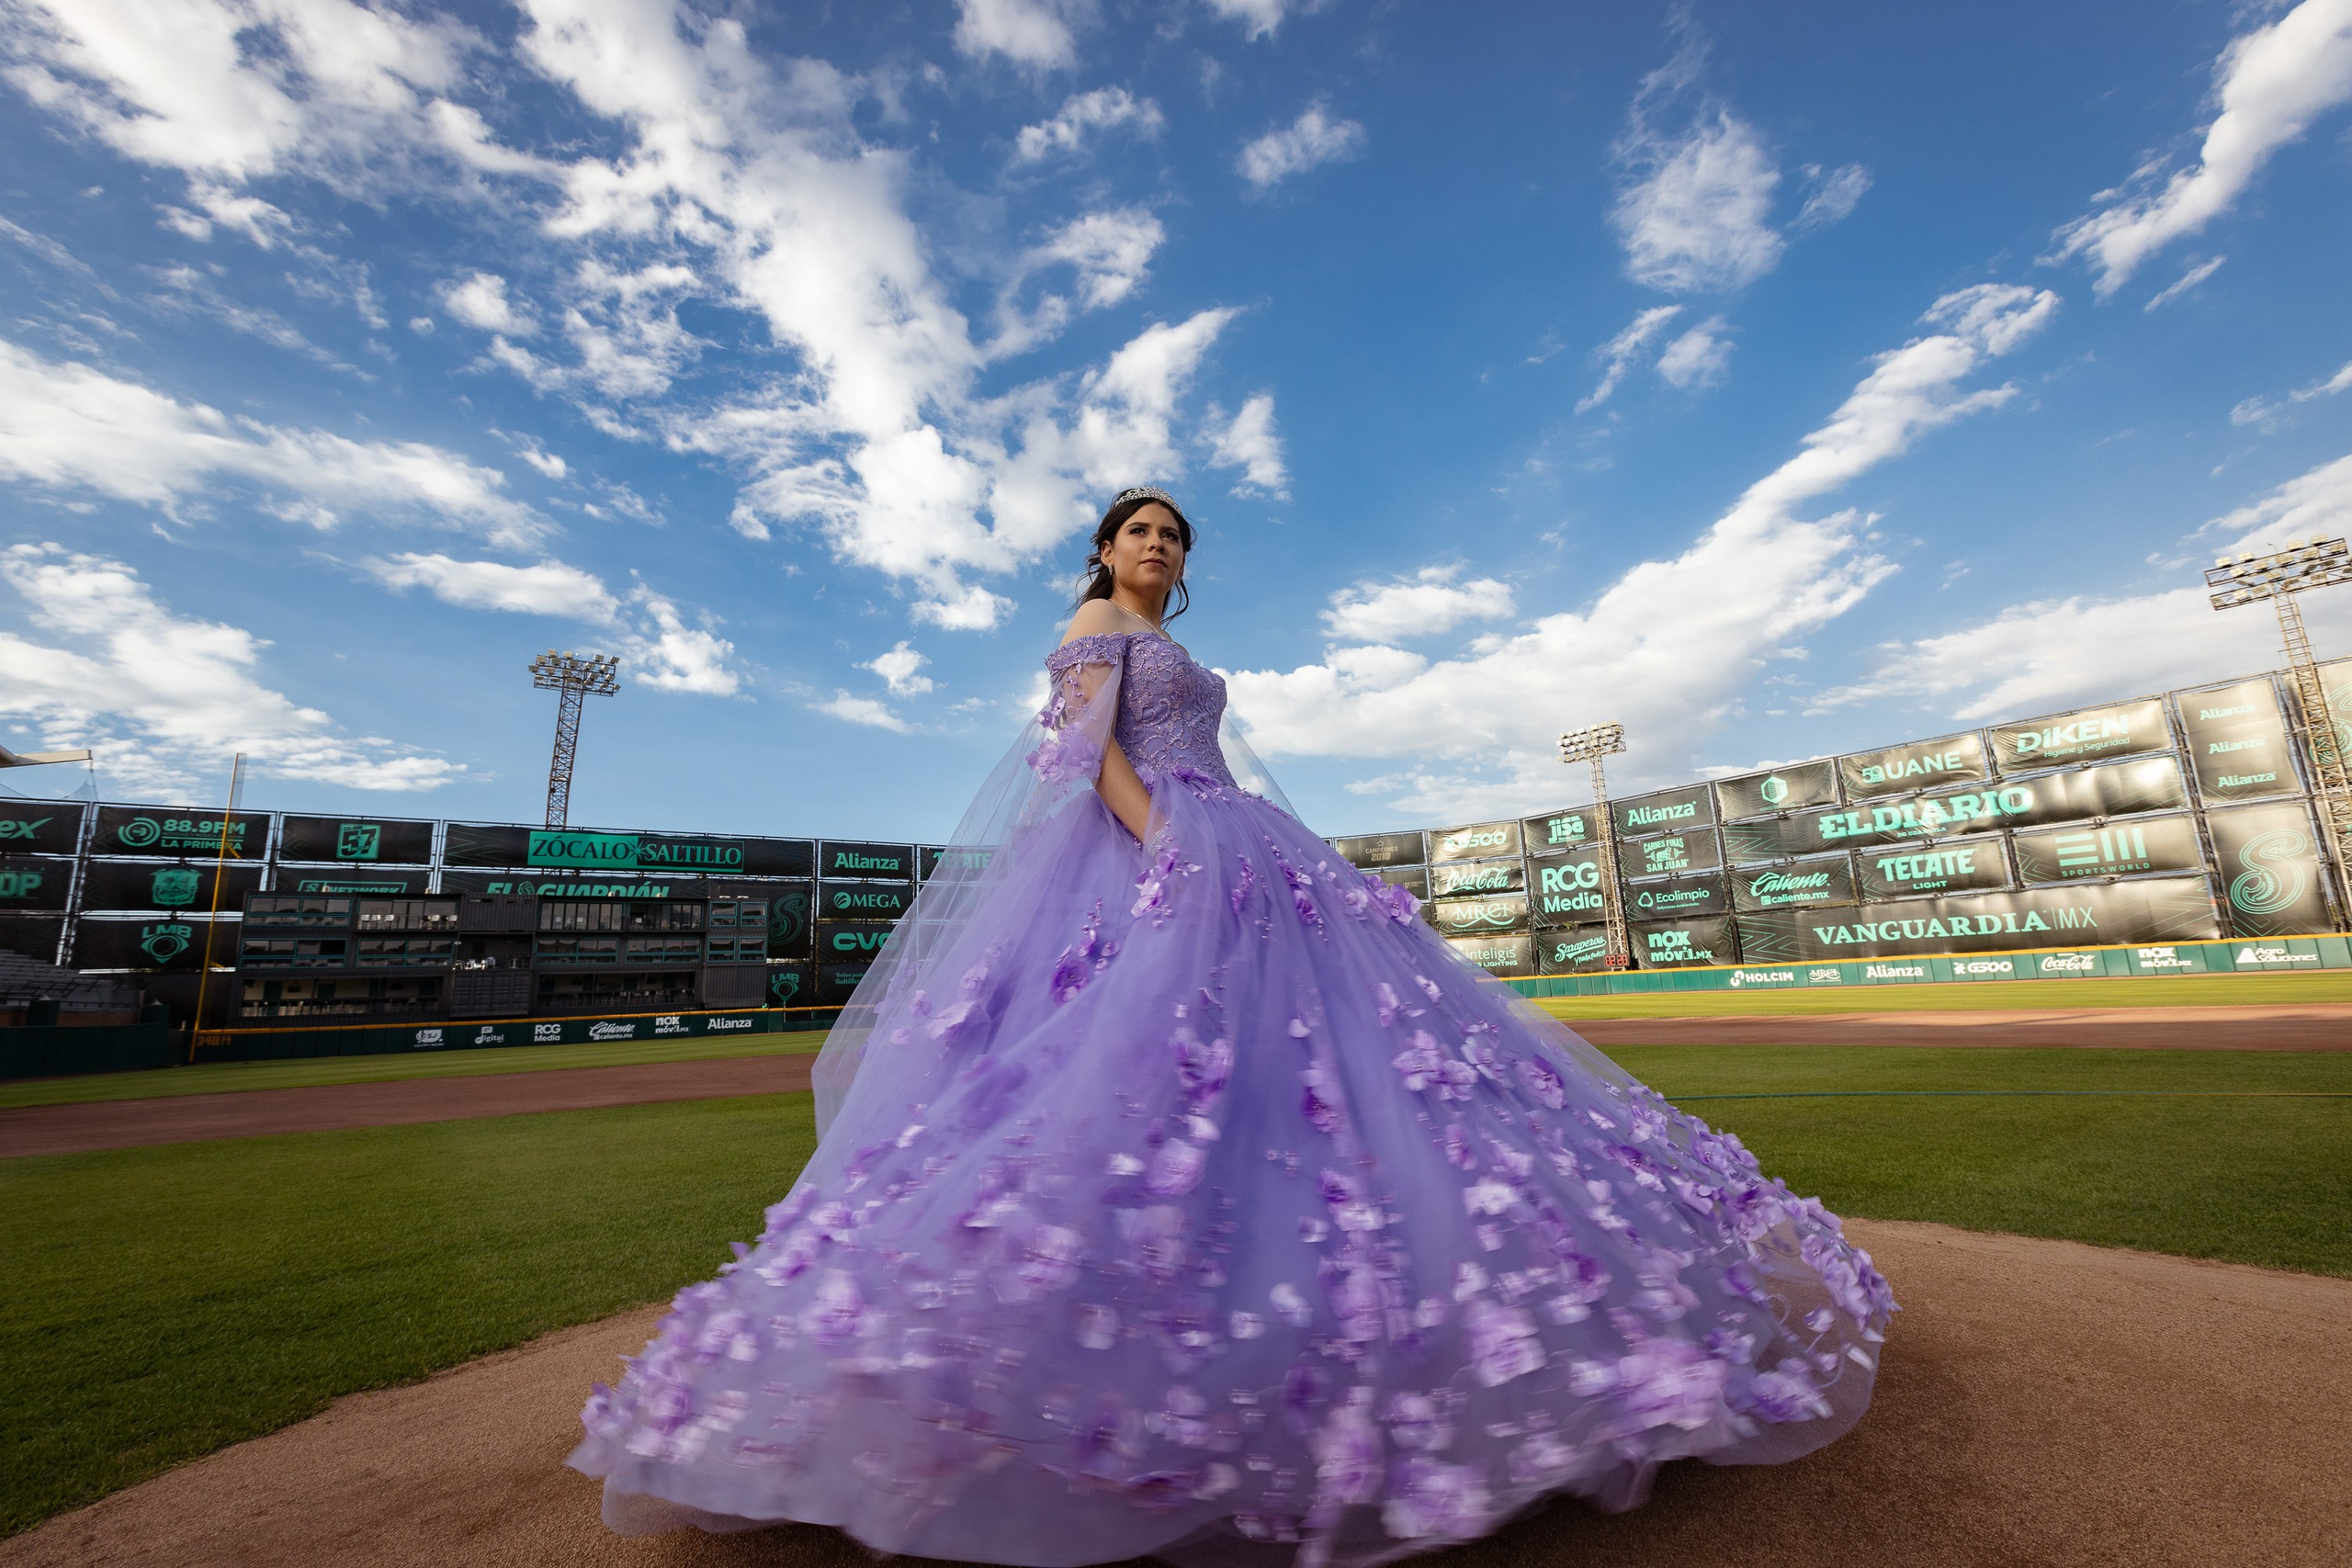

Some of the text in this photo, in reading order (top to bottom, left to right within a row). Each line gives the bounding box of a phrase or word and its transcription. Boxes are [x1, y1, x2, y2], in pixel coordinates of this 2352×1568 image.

[2199, 705, 2256, 721] Alianza
[2018, 714, 2129, 753] DIKEN
[2044, 737, 2131, 758] Higiene y Seguridad
[2209, 739, 2266, 755] Alianza
[2217, 772, 2277, 788] Alianza
[1627, 801, 1697, 827] Alianza
[161, 840, 179, 848] LA
[341, 829, 378, 855] 57
[1643, 838, 1684, 853] CARNES FINAS
[531, 835, 742, 865] ZÓCALO SALTILLO
[1365, 846, 1398, 854] CAMPEONES
[1371, 852, 1391, 862] 2010
[834, 852, 901, 871] Alianza
[1645, 859, 1689, 873] SAN JUAN
[1876, 848, 1978, 882] TECATE
[1541, 862, 1599, 894] RCG
[1913, 880, 1948, 890] LIGHT
[852, 894, 901, 908] MEGA
[1544, 891, 1604, 914] Media
[1656, 887, 1710, 903] Ecolimpio
[1771, 891, 1830, 904] caliente.mx
[141, 924, 192, 939] LMB
[1813, 910, 2051, 945] VANGUARDIA
[1647, 931, 1691, 948] nox
[1555, 936, 1606, 962] Saraperos
[2255, 948, 2285, 957] Agro
[2256, 953, 2318, 964] Soluciones
[1745, 972, 1794, 983] HOLCIM
[1866, 964, 1924, 978] Alianza
[772, 973, 799, 985] LMB
[535, 1023, 561, 1034] RCG
[707, 1018, 753, 1030] Alianza
